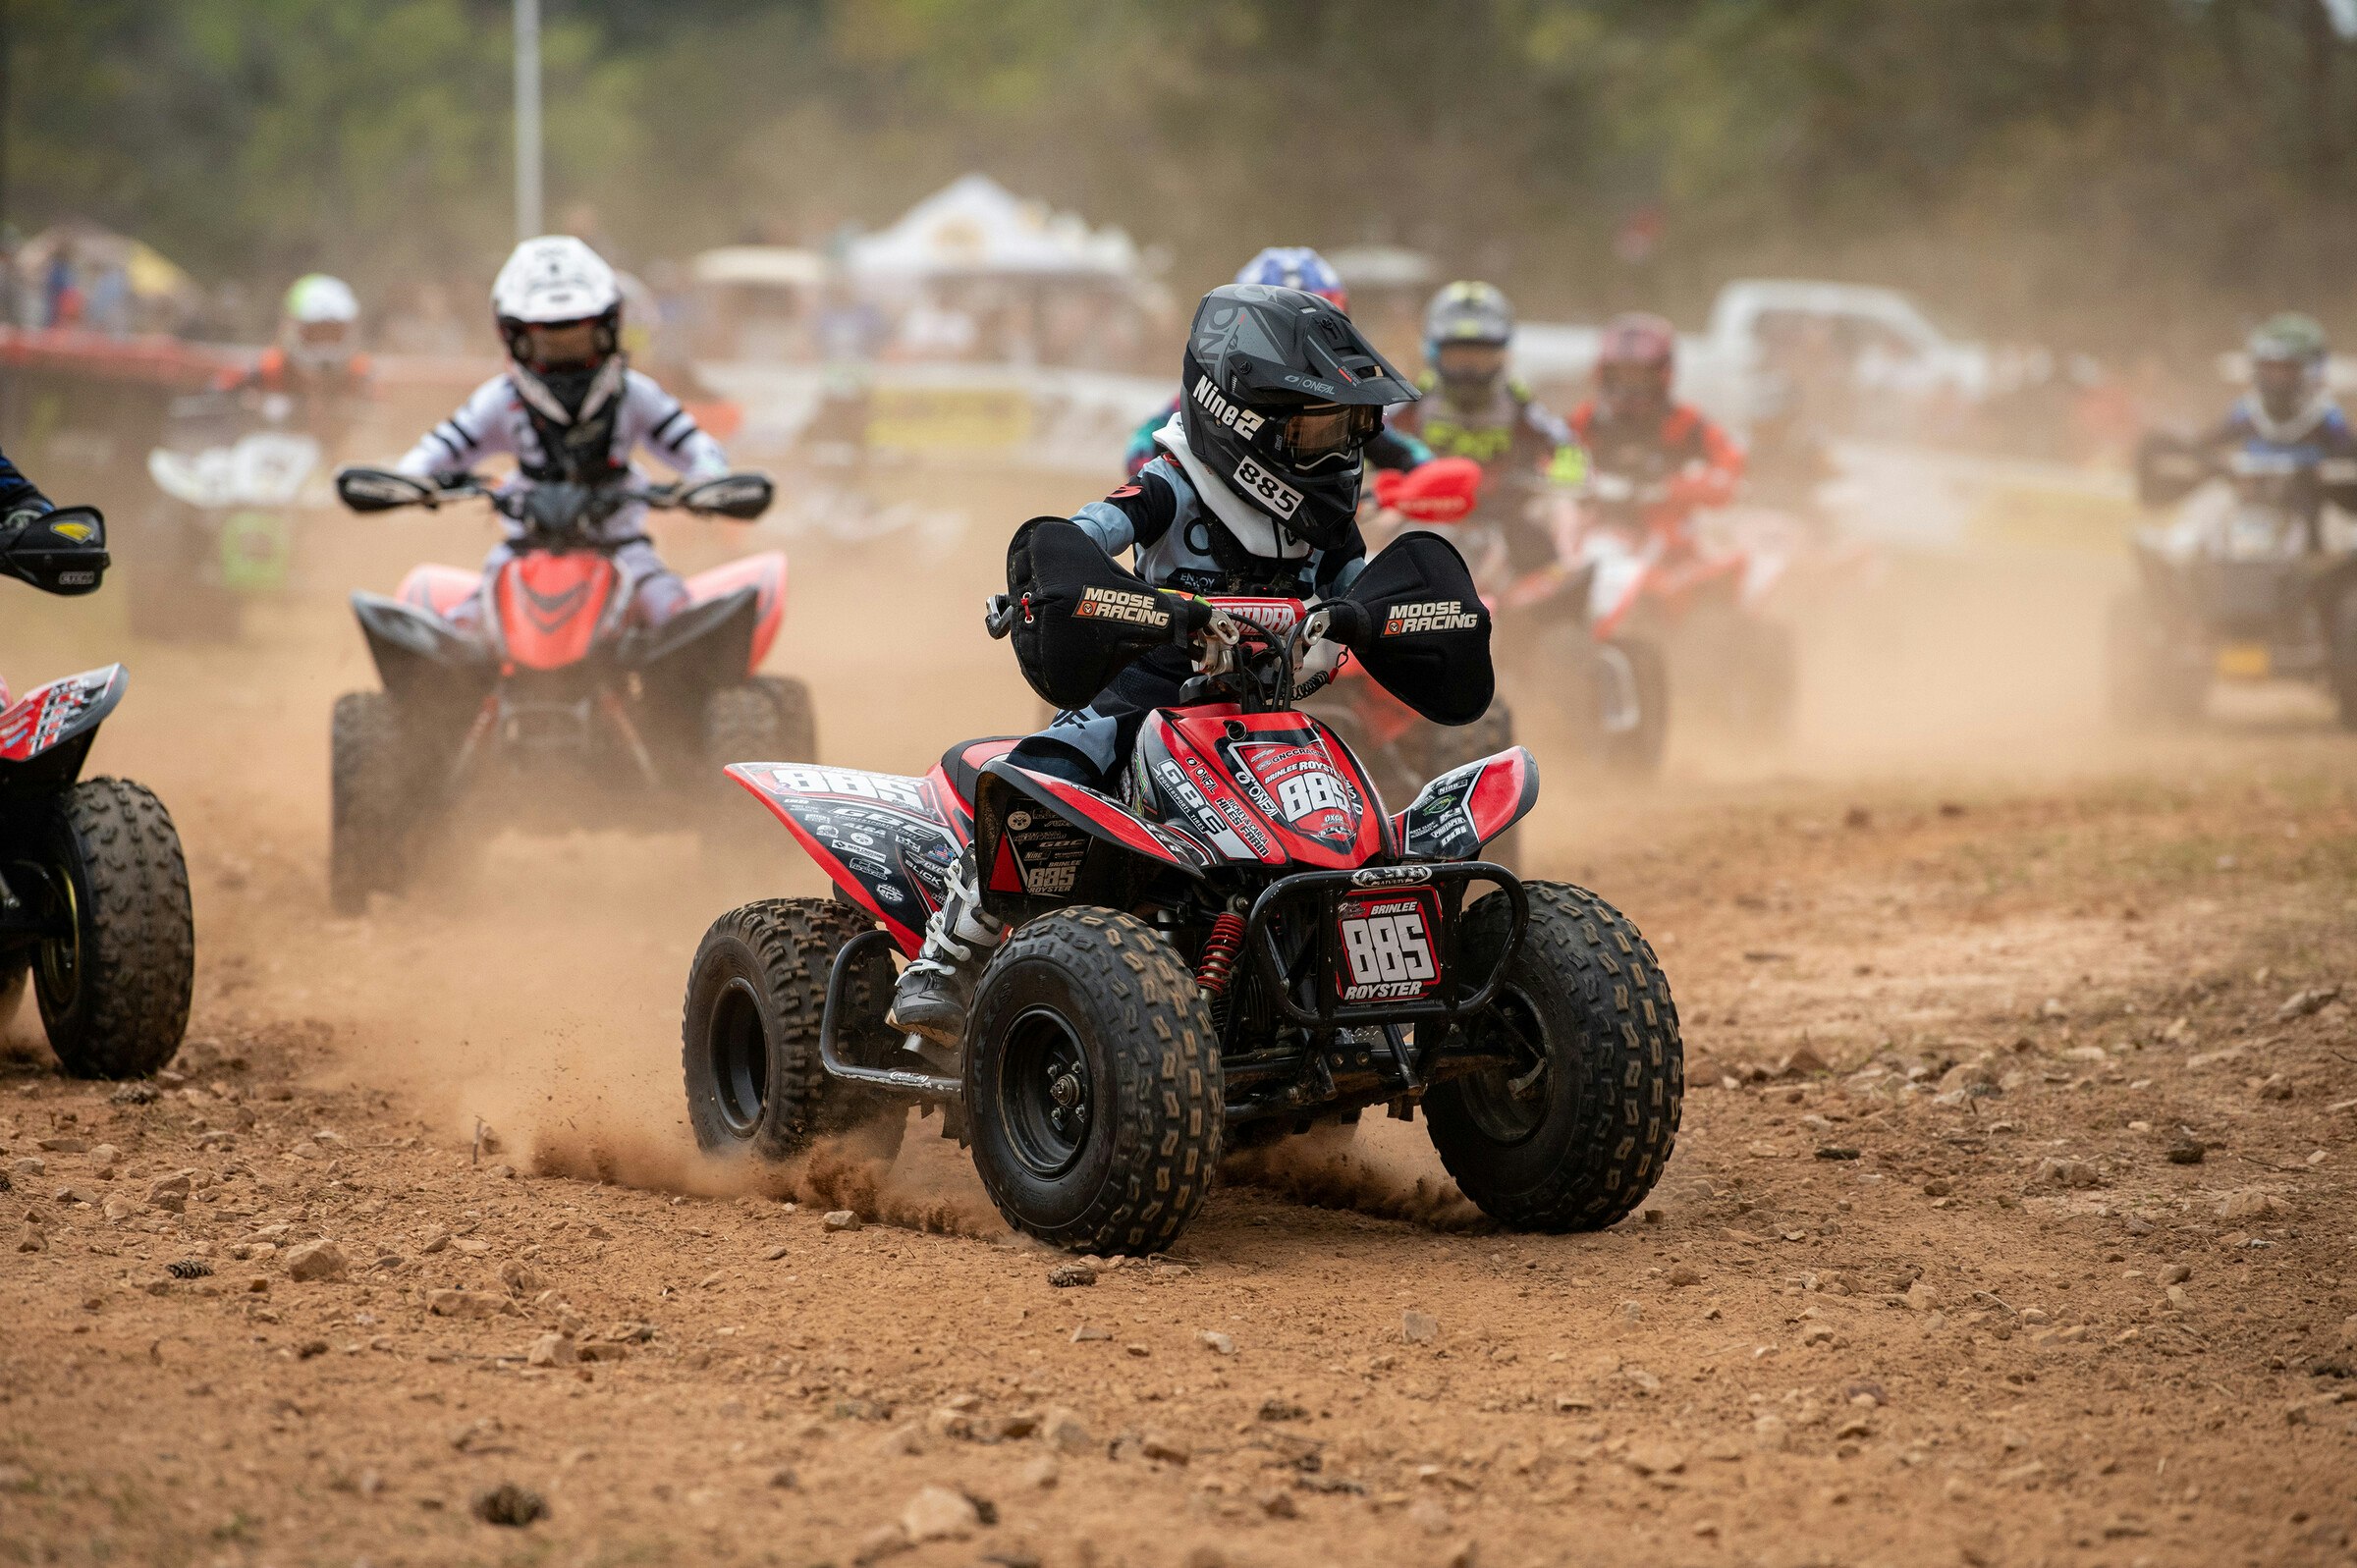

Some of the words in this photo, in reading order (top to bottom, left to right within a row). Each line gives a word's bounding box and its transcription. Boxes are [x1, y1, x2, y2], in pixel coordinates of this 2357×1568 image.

[1192, 374, 1266, 441] Nine2
[1238, 462, 1299, 513] 885
[1084, 588, 1155, 609] MOOSE
[1389, 601, 1461, 620] MOOSE
[1094, 603, 1170, 626] RACING
[1400, 614, 1478, 633] RACING
[1264, 764, 1298, 785] BRINLEE
[772, 770, 924, 810] 885
[1160, 760, 1226, 834] GBC
[1277, 772, 1349, 823] 885
[1217, 798, 1242, 826] HILES
[1228, 798, 1248, 822] RICKEY
[1250, 824, 1268, 844] CARLA
[1028, 867, 1076, 888] 885
[1370, 901, 1418, 915] BRINLEE
[1342, 913, 1435, 985] 885
[1344, 981, 1423, 1000] ROYSTER
